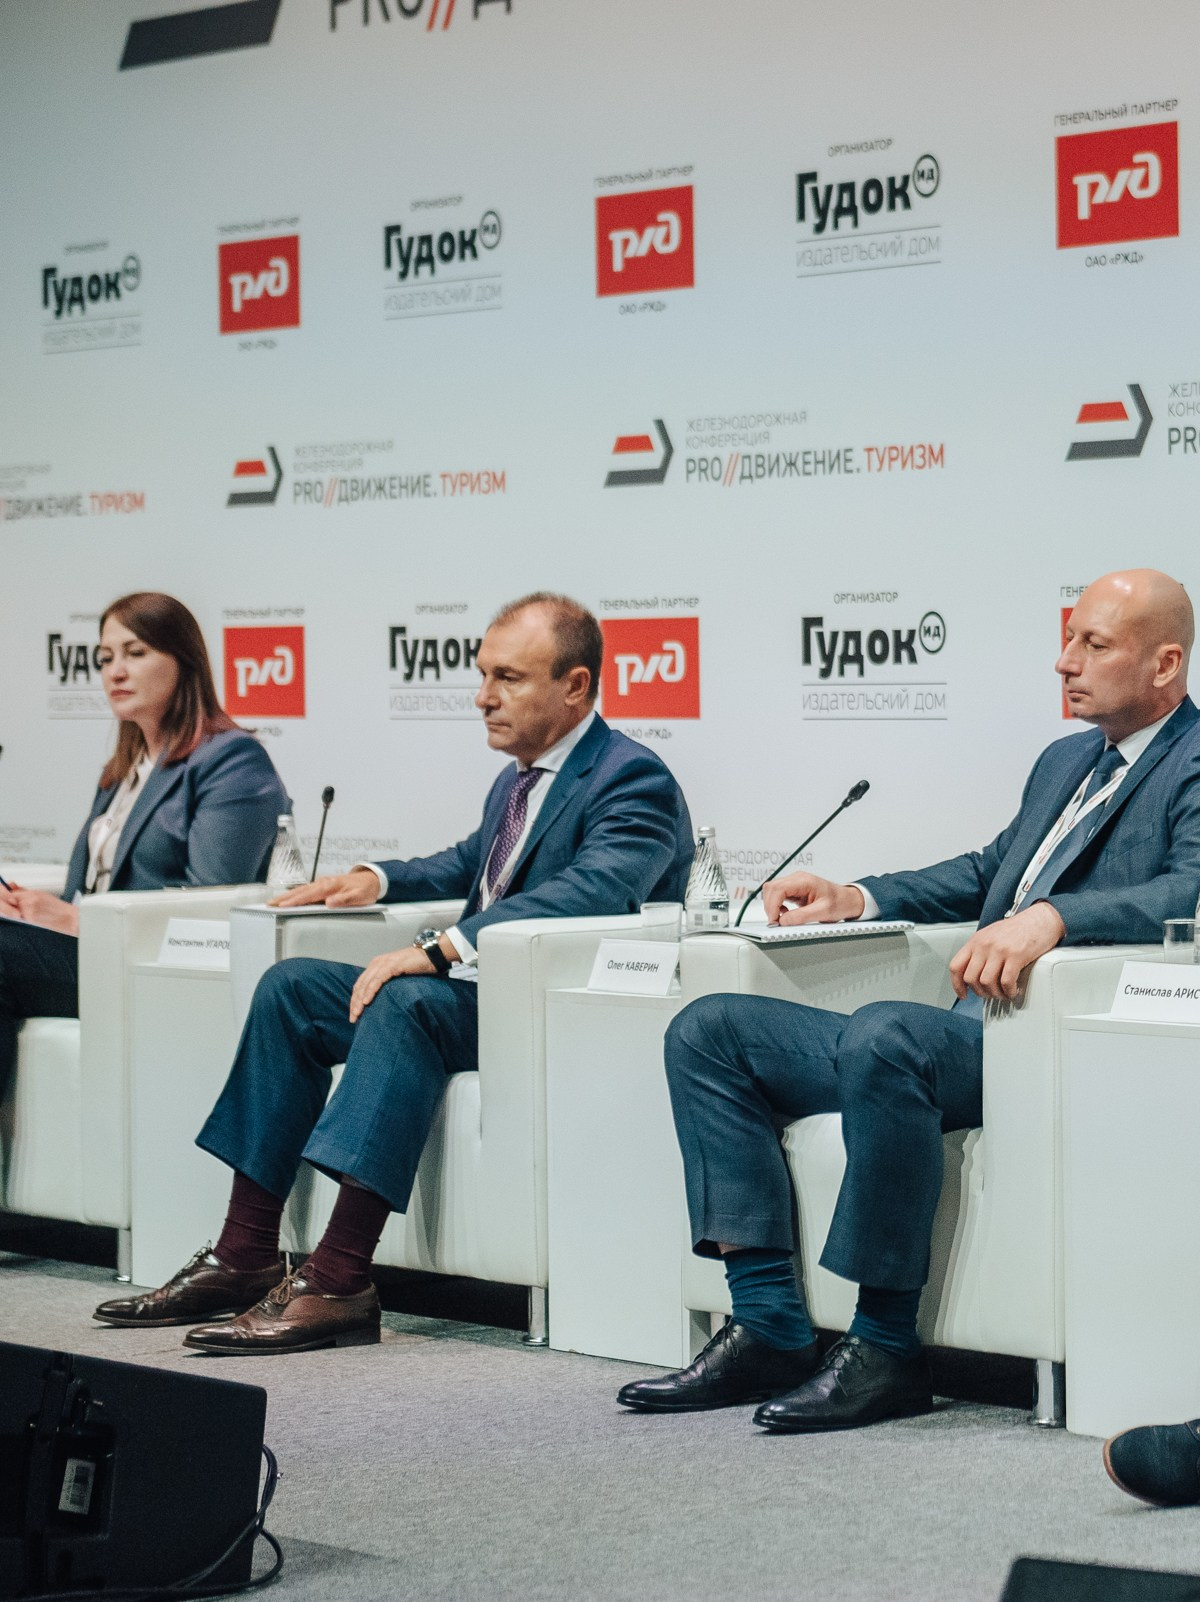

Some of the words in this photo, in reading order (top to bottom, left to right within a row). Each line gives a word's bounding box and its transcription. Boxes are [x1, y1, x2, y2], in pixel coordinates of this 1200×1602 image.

[1054, 103, 1128, 126] ГЕНЕРАЛЬНЫЙ
[1131, 99, 1178, 115] ПАРТНЕР
[827, 138, 893, 158] ОРГАНИЗАТОР
[796, 171, 911, 235] Гудок
[384, 224, 478, 281] Гудок
[796, 236, 903, 267] издательский
[907, 236, 941, 257] дом
[1085, 254, 1107, 268] ОАО
[1109, 251, 1144, 265] «РЖД»
[686, 411, 808, 433] ЖЕЛЕЗНОДОРОЖНАЯ
[685, 431, 771, 450] КОНФЕРЕНЦИЯ
[600, 597, 658, 610] ГЕНЕРАЛЬНЫЙ
[661, 597, 699, 609] ПАРТНЕР
[833, 591, 899, 605] ОРГАНИЗАТОР
[801, 616, 918, 680] Гудок
[801, 688, 909, 713] издательский
[913, 692, 946, 713] дом
[607, 959, 624, 971] Олег
[625, 961, 660, 973] КАВЕРИН
[1124, 984, 1172, 998] Станислав
